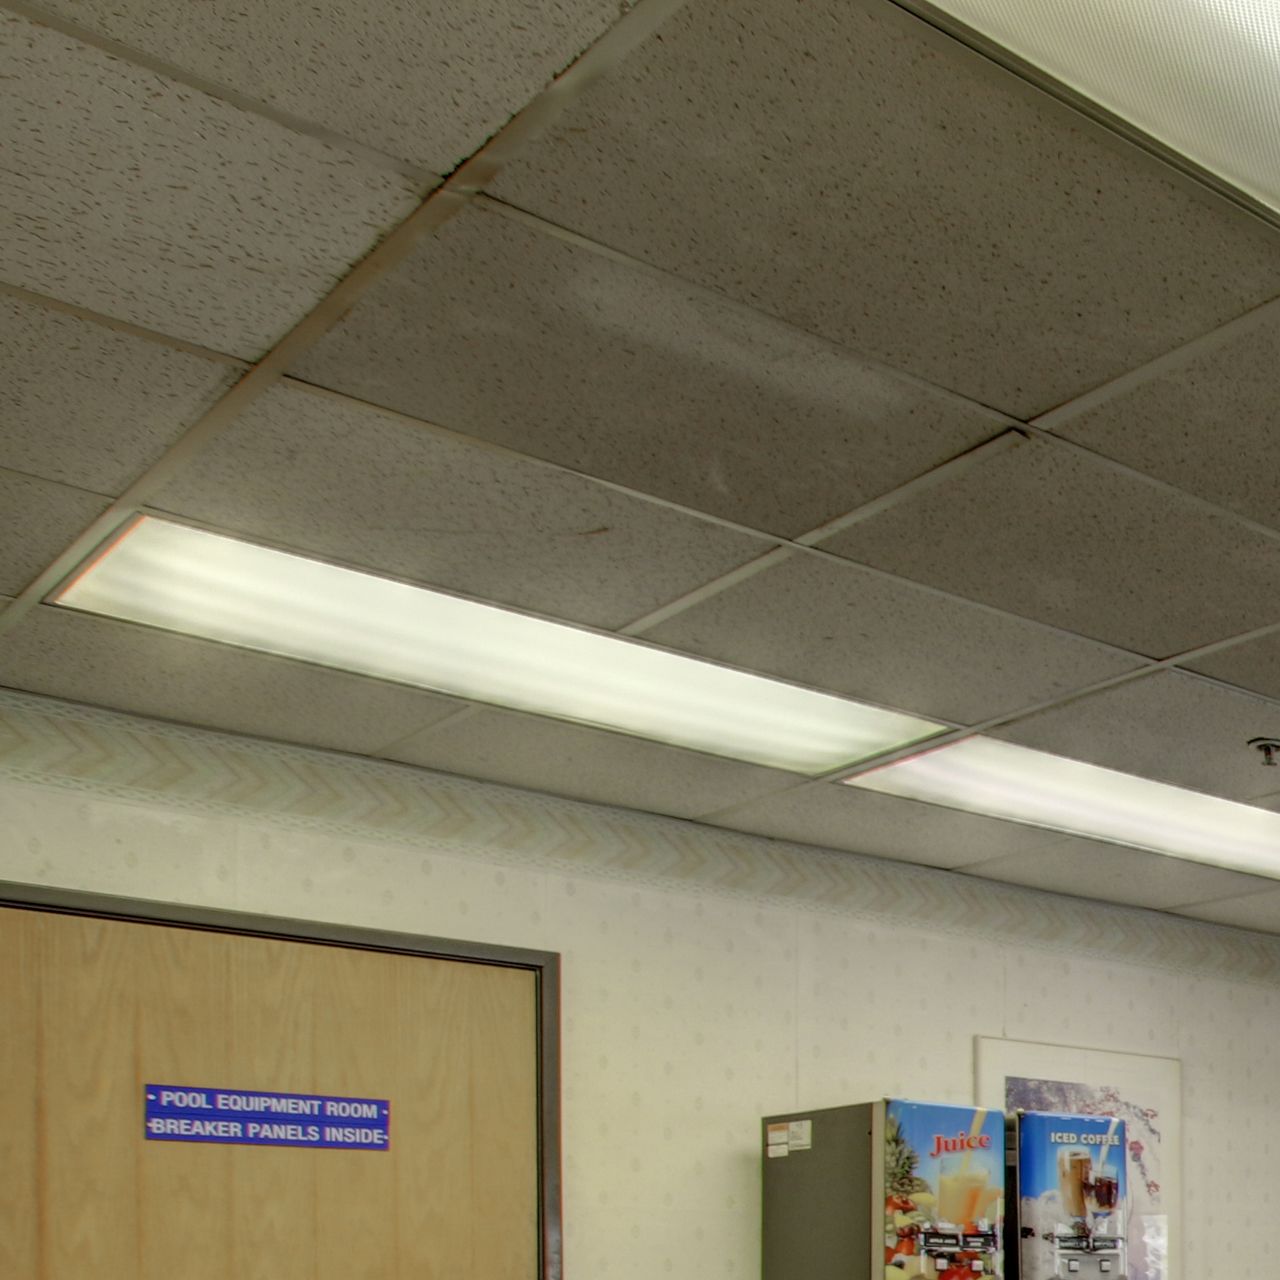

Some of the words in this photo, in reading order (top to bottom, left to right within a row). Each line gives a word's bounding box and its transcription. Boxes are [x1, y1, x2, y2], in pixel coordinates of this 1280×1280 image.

[160, 1091, 213, 1109] POOL
[216, 1093, 322, 1116] EQUIPMENT
[327, 1101, 378, 1119] ROOM
[152, 1118, 242, 1138] BREAKER
[249, 1123, 320, 1142] PANELS
[325, 1127, 384, 1145] INSIDE
[1051, 1132, 1076, 1144] ICED
[1080, 1133, 1120, 1146] COFFEE
[930, 1132, 991, 1158] Juice
